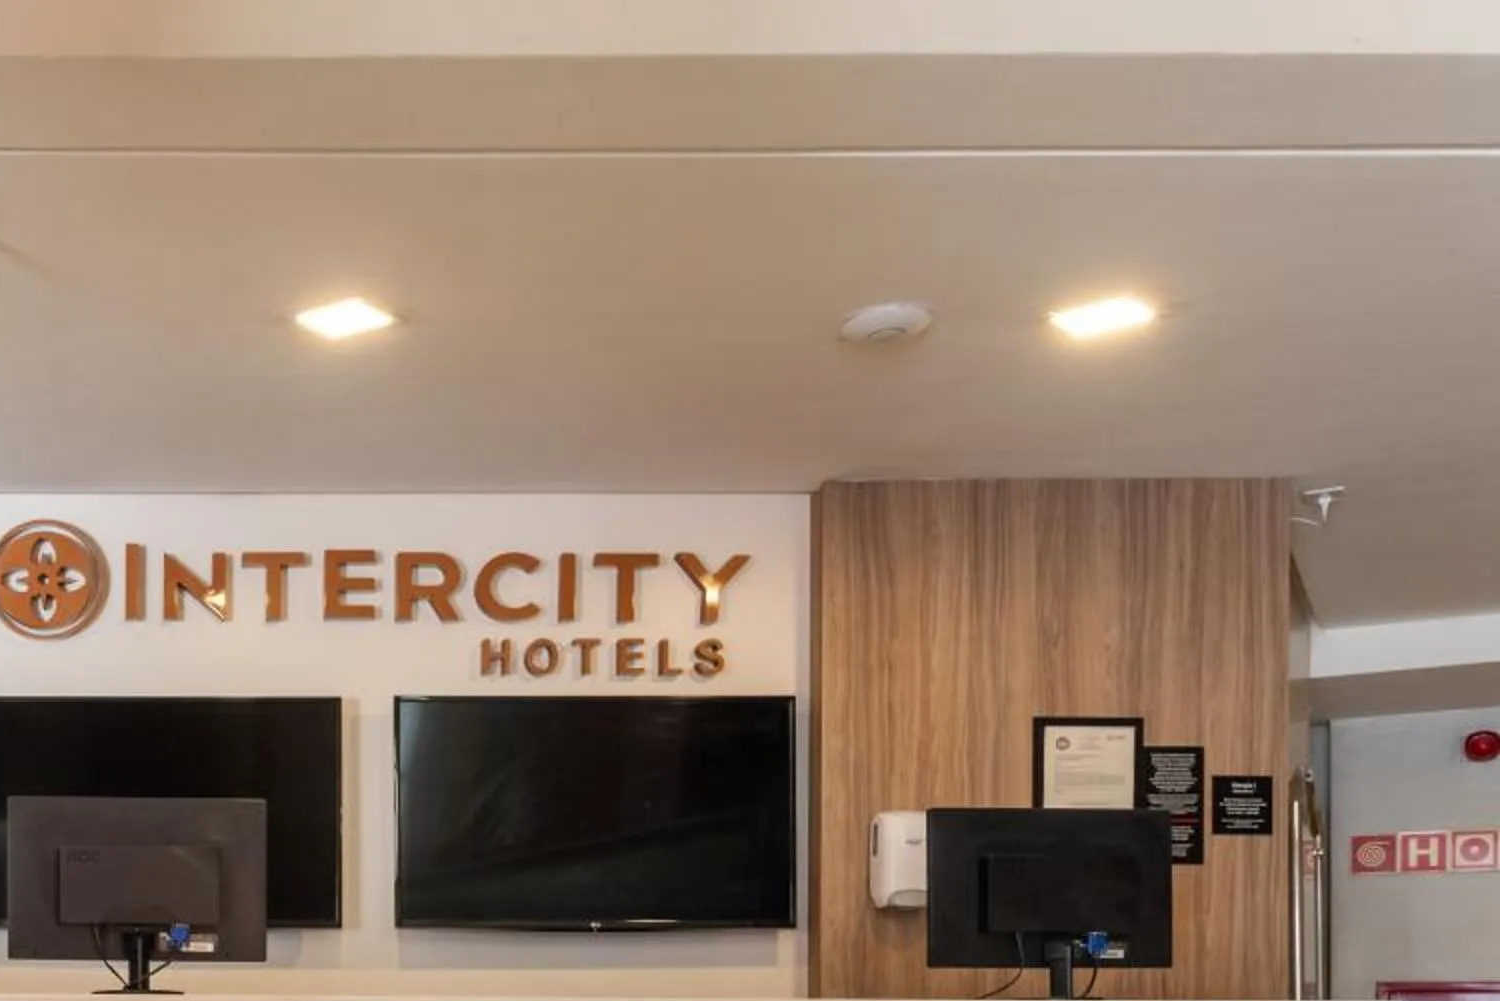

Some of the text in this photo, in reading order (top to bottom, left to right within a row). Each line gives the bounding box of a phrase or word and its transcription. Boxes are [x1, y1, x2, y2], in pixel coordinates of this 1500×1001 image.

[125, 543, 752, 625] INTERCITY
[479, 638, 727, 678] HOTELS
[1408, 837, 1440, 867] H
